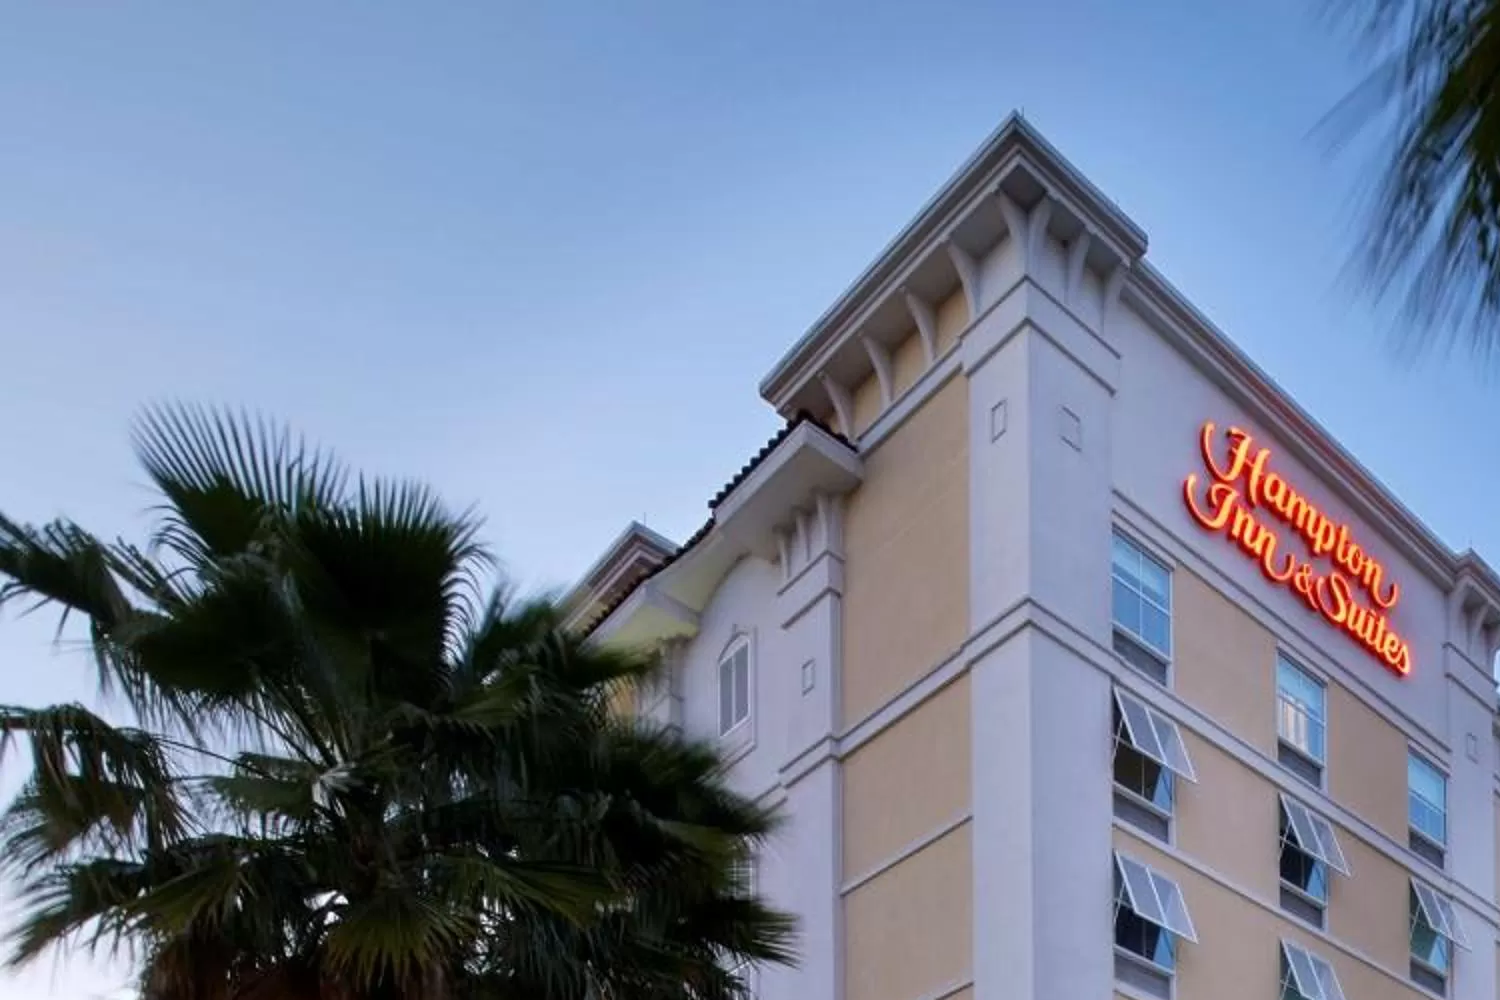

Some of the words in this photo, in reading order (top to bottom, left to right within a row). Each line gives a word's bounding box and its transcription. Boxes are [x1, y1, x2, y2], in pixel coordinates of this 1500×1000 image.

[1184, 472, 1297, 584] Inn
[1291, 562, 1320, 613] &
[1316, 571, 1413, 677] Suites
[1200, 420, 1400, 609] Hampton
